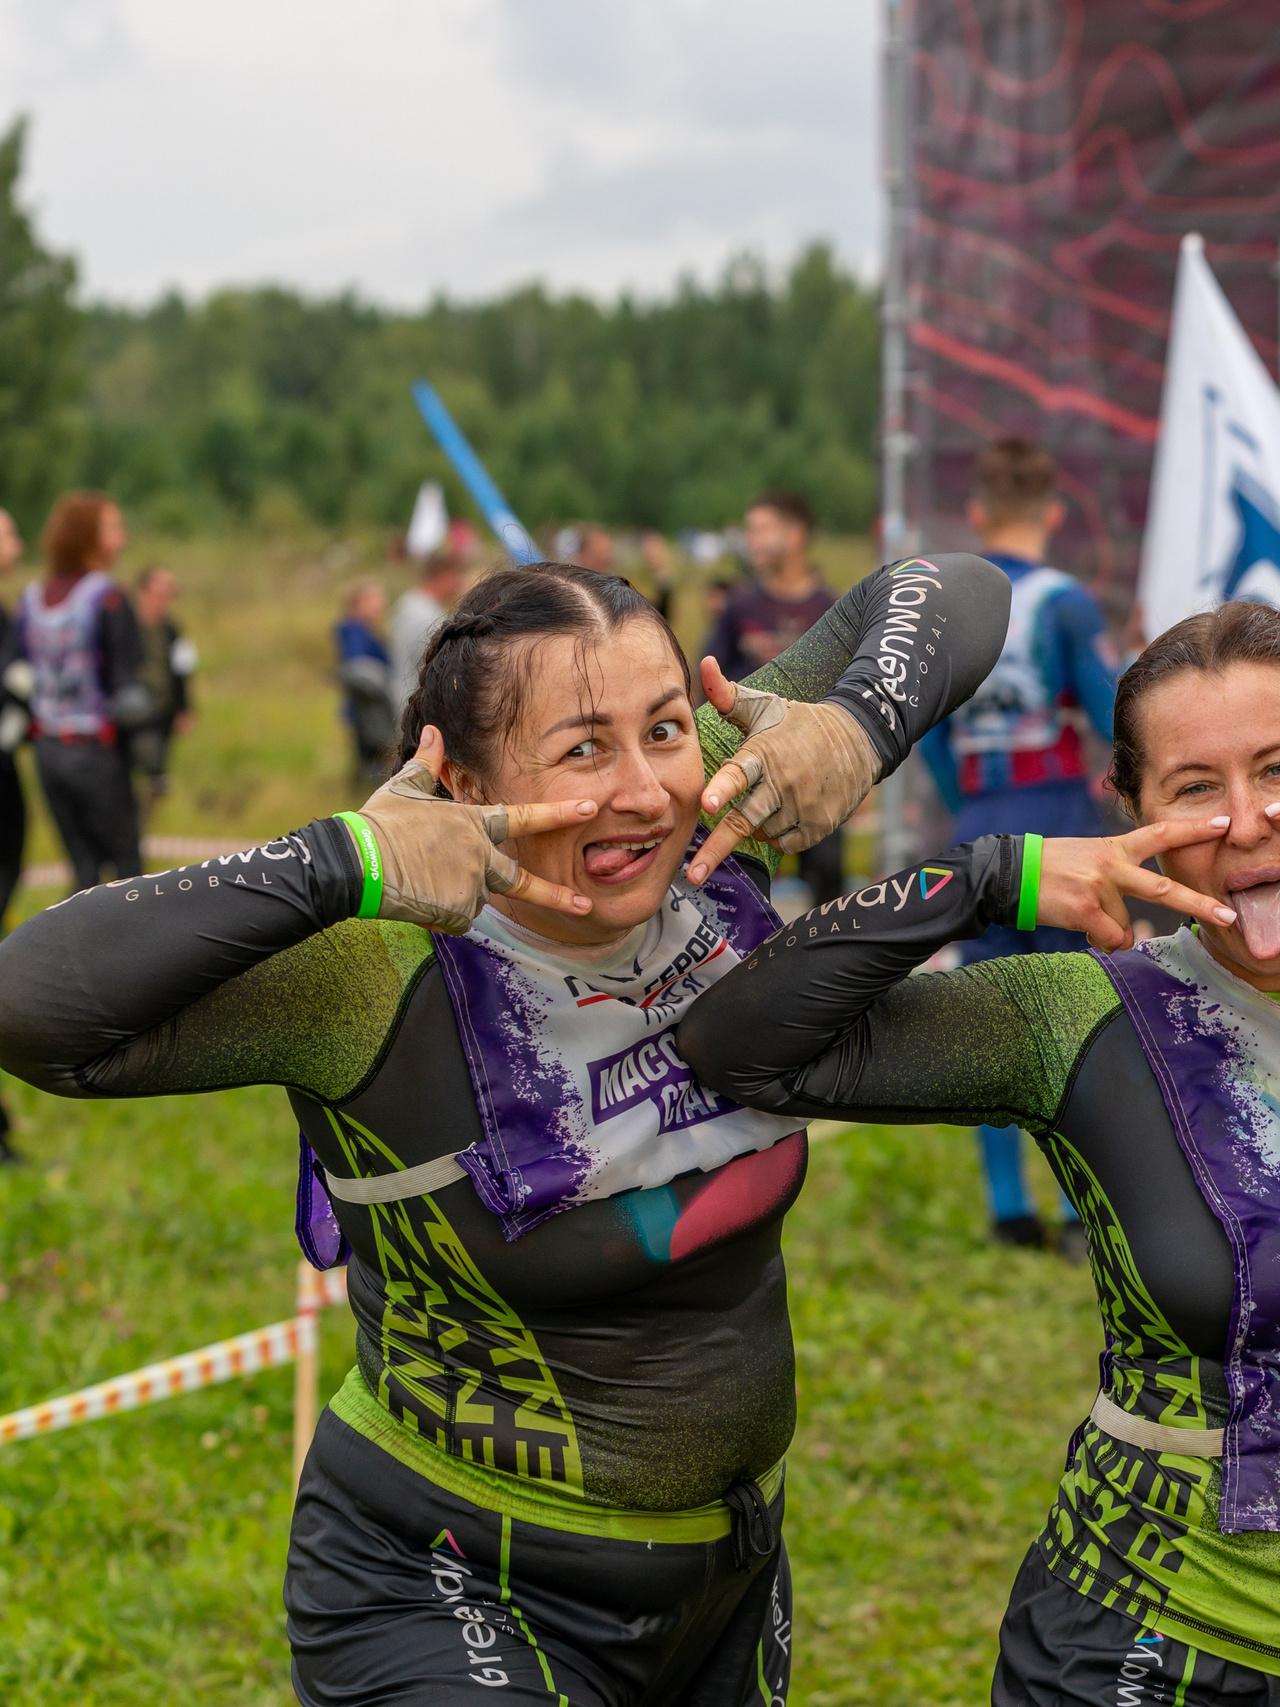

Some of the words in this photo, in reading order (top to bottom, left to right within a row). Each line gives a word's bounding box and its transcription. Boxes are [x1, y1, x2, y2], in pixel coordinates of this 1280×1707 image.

[908, 614, 948, 708] GOBAL
[361, 828, 380, 874] Greenway
[124, 872, 273, 902] GLOBAL
[747, 918, 862, 970] GLOBAL
